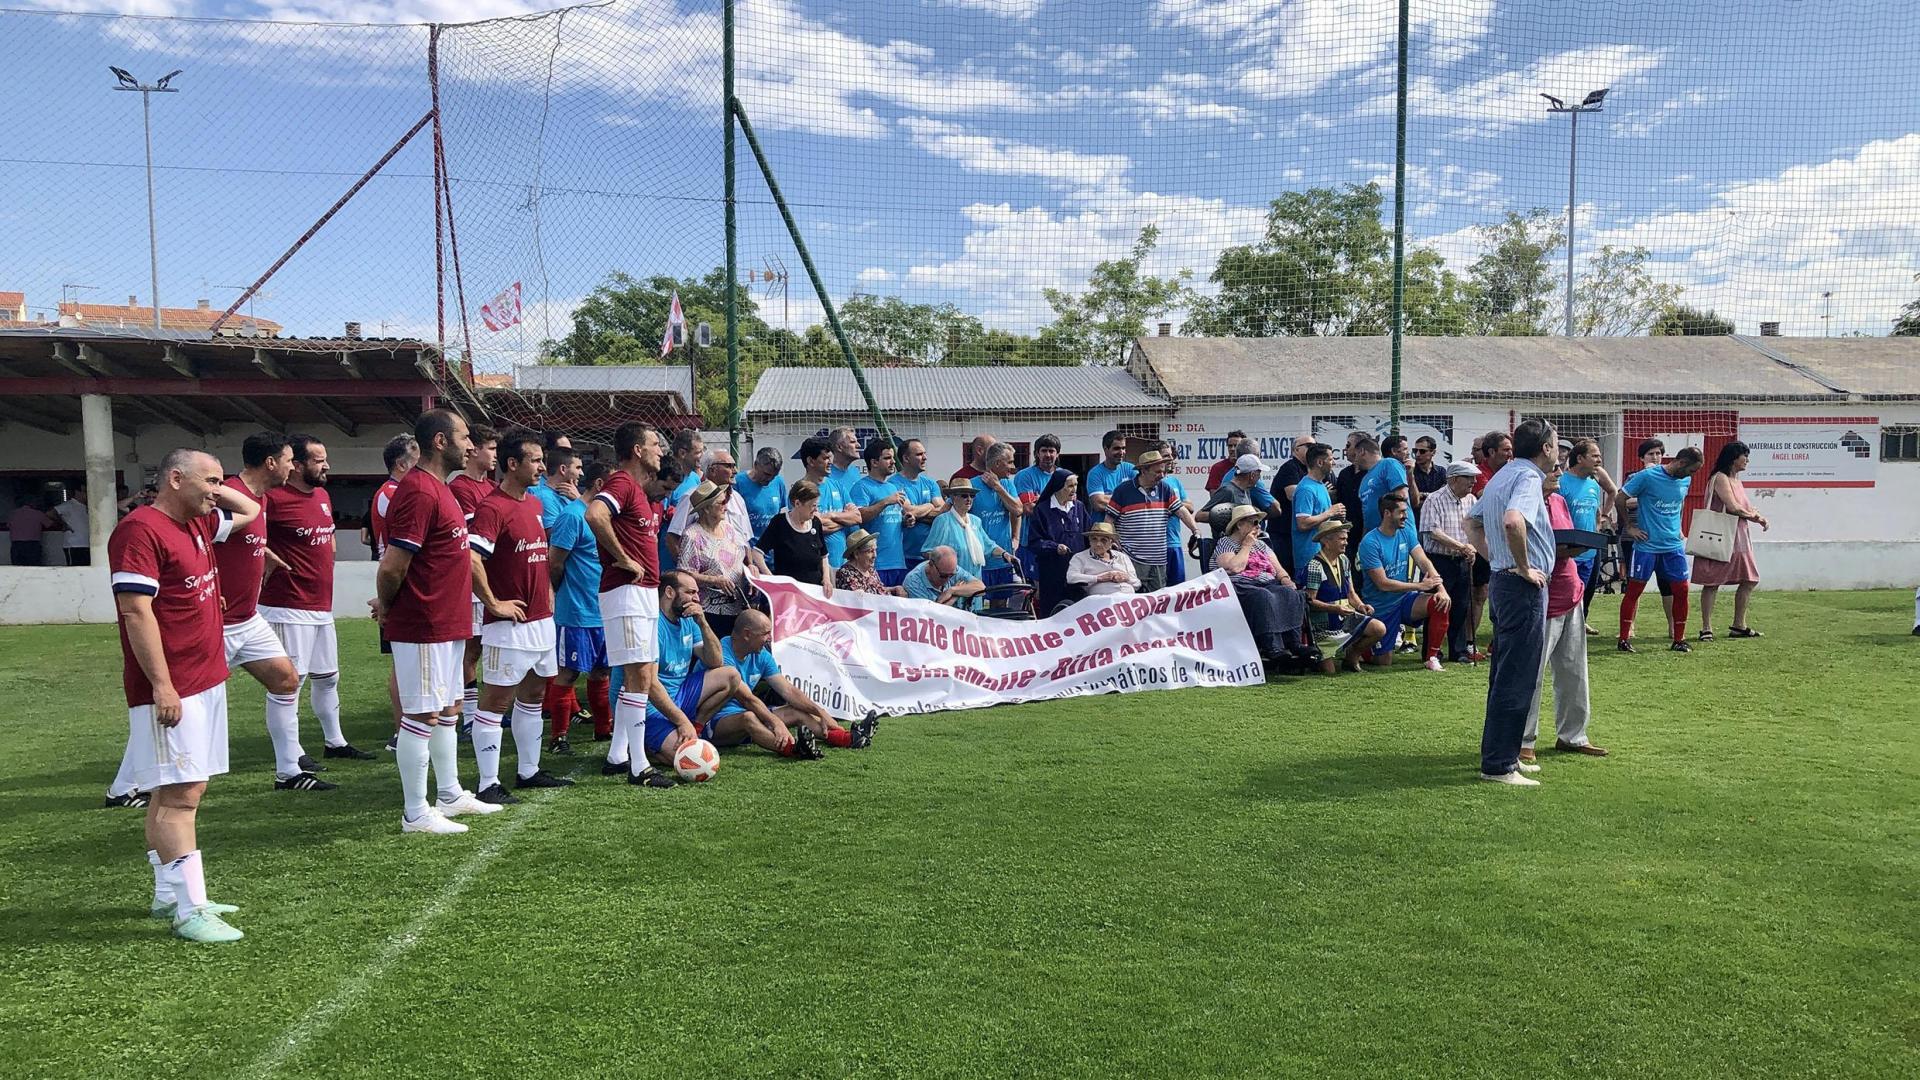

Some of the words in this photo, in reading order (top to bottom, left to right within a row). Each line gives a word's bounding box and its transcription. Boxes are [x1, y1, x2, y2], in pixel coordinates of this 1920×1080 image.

[1167, 424, 1182, 432] DE
[1186, 424, 1205, 432] DIA
[1749, 442, 1783, 450] MATERIALES
[1792, 441, 1838, 450] CONSTRUCCIÓN
[1772, 452, 1790, 461] ÁNGEL
[1791, 453, 1810, 461] LOREA
[296, 526, 314, 537] Soy
[515, 537, 527, 553] Ni
[878, 611, 949, 650] Hazte
[951, 626, 1064, 659] donante
[1076, 594, 1171, 636] Regala
[571, 651, 578, 662] 6
[1171, 660, 1189, 684] de
[1194, 661, 1262, 684] Navarra
